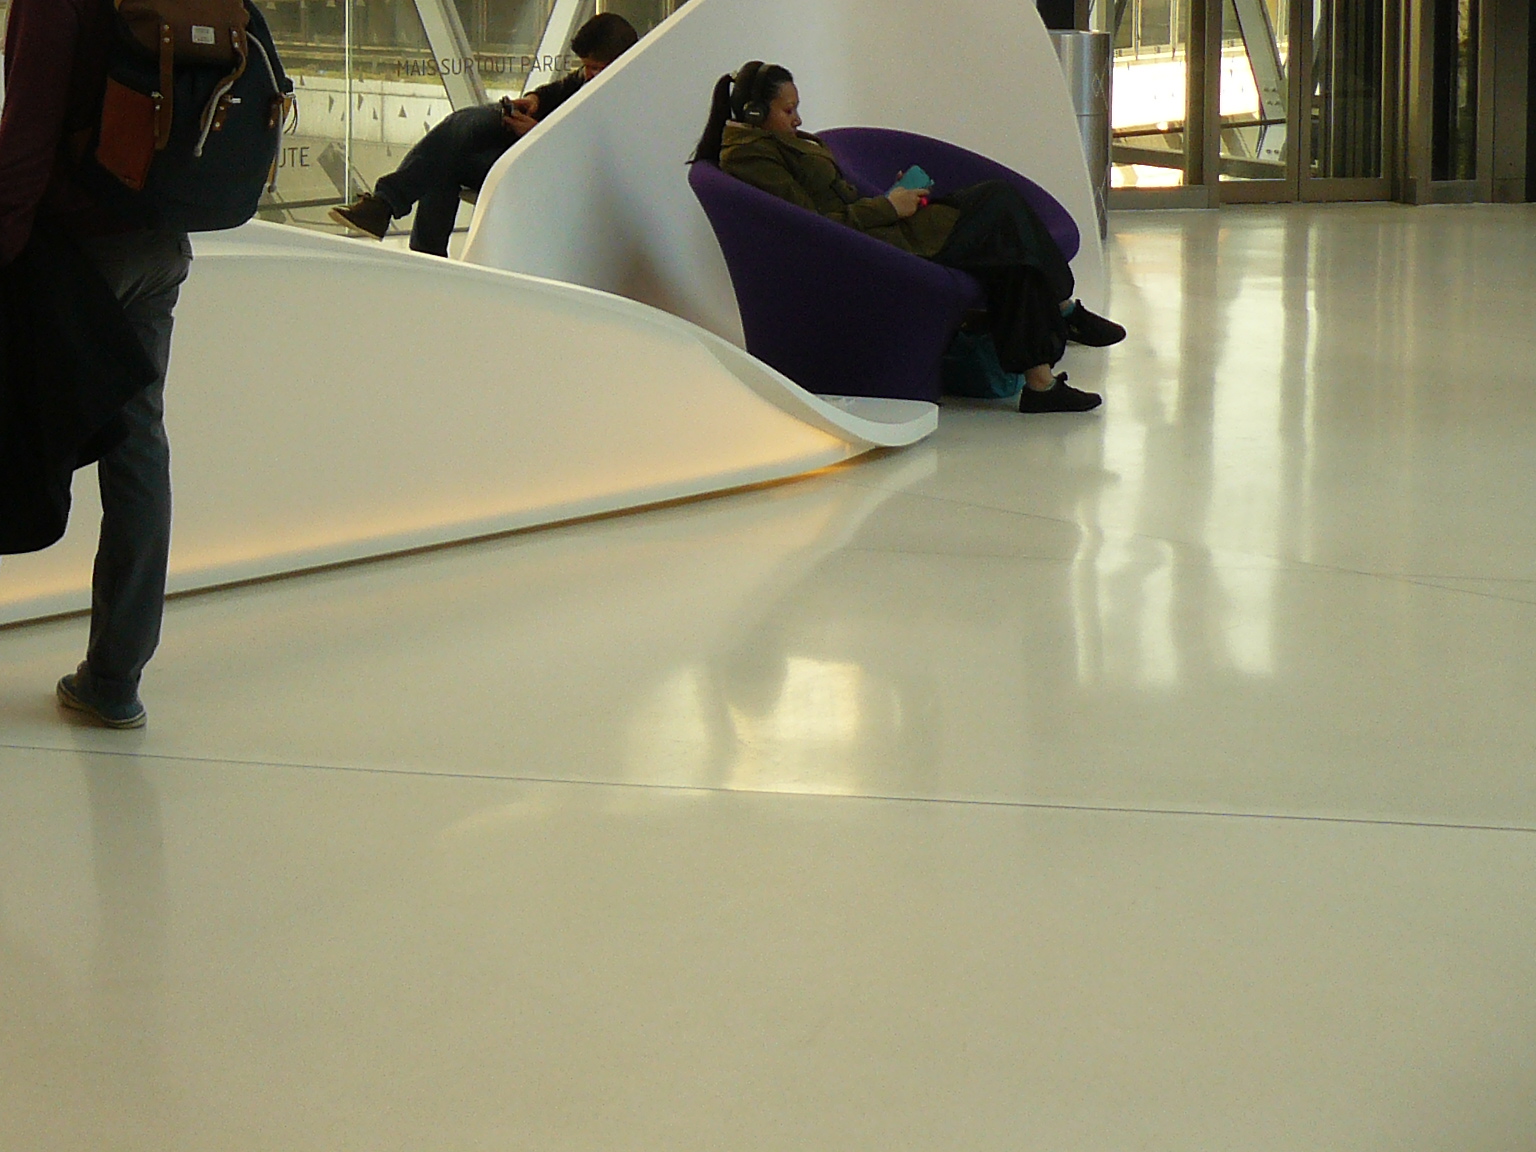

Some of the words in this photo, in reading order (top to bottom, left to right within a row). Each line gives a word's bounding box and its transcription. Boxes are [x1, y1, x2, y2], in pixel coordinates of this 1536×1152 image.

[396, 58, 437, 77] MAIS
[440, 55, 516, 76] SURTOUT
[520, 53, 572, 73] PARCE
